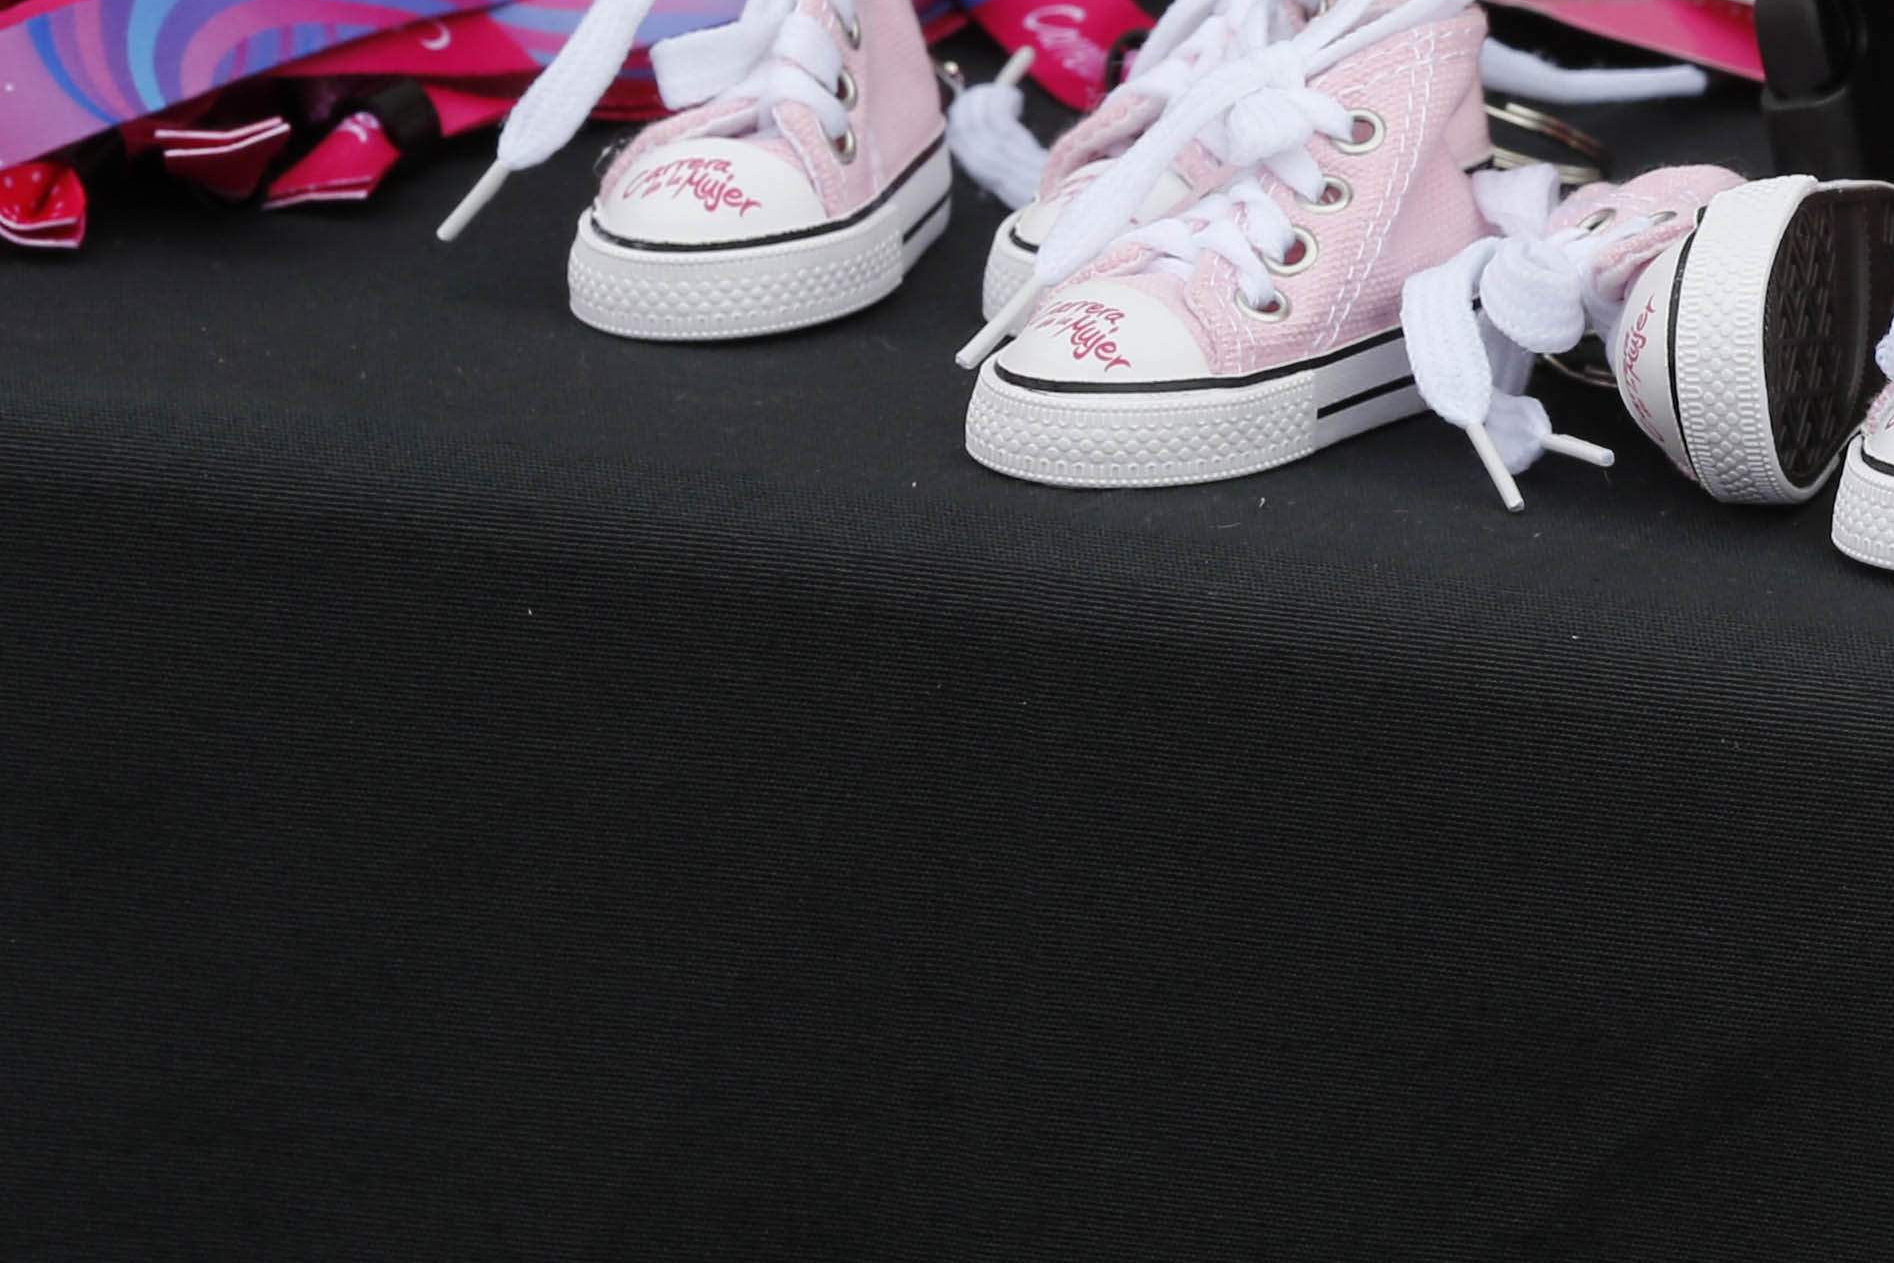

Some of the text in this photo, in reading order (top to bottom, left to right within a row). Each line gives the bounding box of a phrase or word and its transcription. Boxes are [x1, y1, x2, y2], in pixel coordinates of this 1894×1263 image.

[622, 158, 732, 200] Carrera
[672, 169, 762, 217] Mujer
[1051, 315, 1131, 372] Mujer
